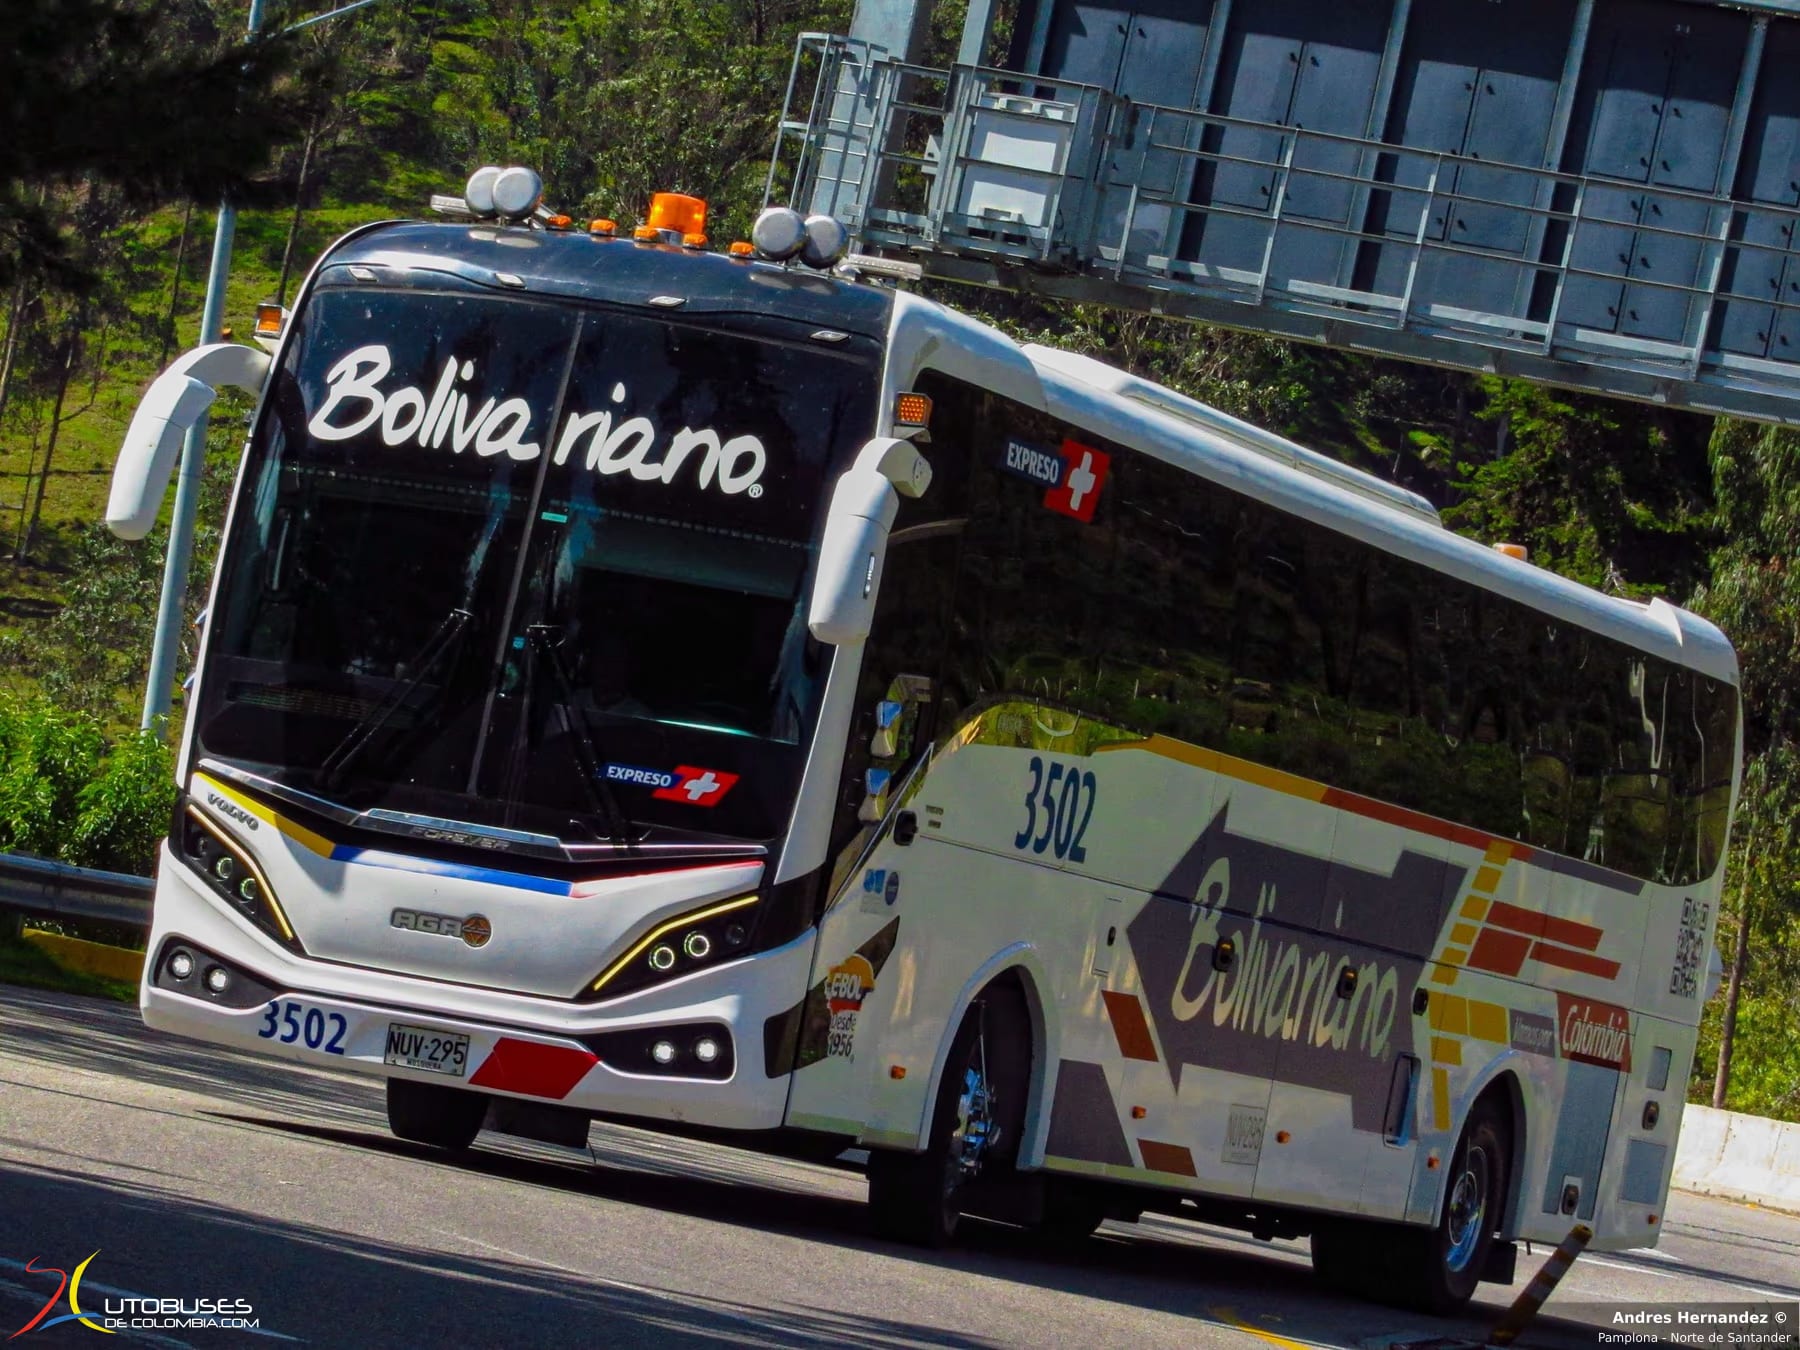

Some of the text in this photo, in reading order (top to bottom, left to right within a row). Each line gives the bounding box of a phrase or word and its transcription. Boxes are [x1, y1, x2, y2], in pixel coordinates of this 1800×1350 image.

[1007, 442, 1059, 484] EXPRESO
[606, 765, 672, 787] EXPRESO
[207, 792, 259, 831] VOLVO
[1015, 756, 1097, 864] 3502
[409, 826, 512, 851] FOREVER
[391, 908, 464, 938] AGA
[1172, 857, 1398, 1058] Bolivariano
[258, 1000, 348, 1055] 3502
[828, 1034, 854, 1057] 1956
[1562, 1004, 1628, 1063] Colombia
